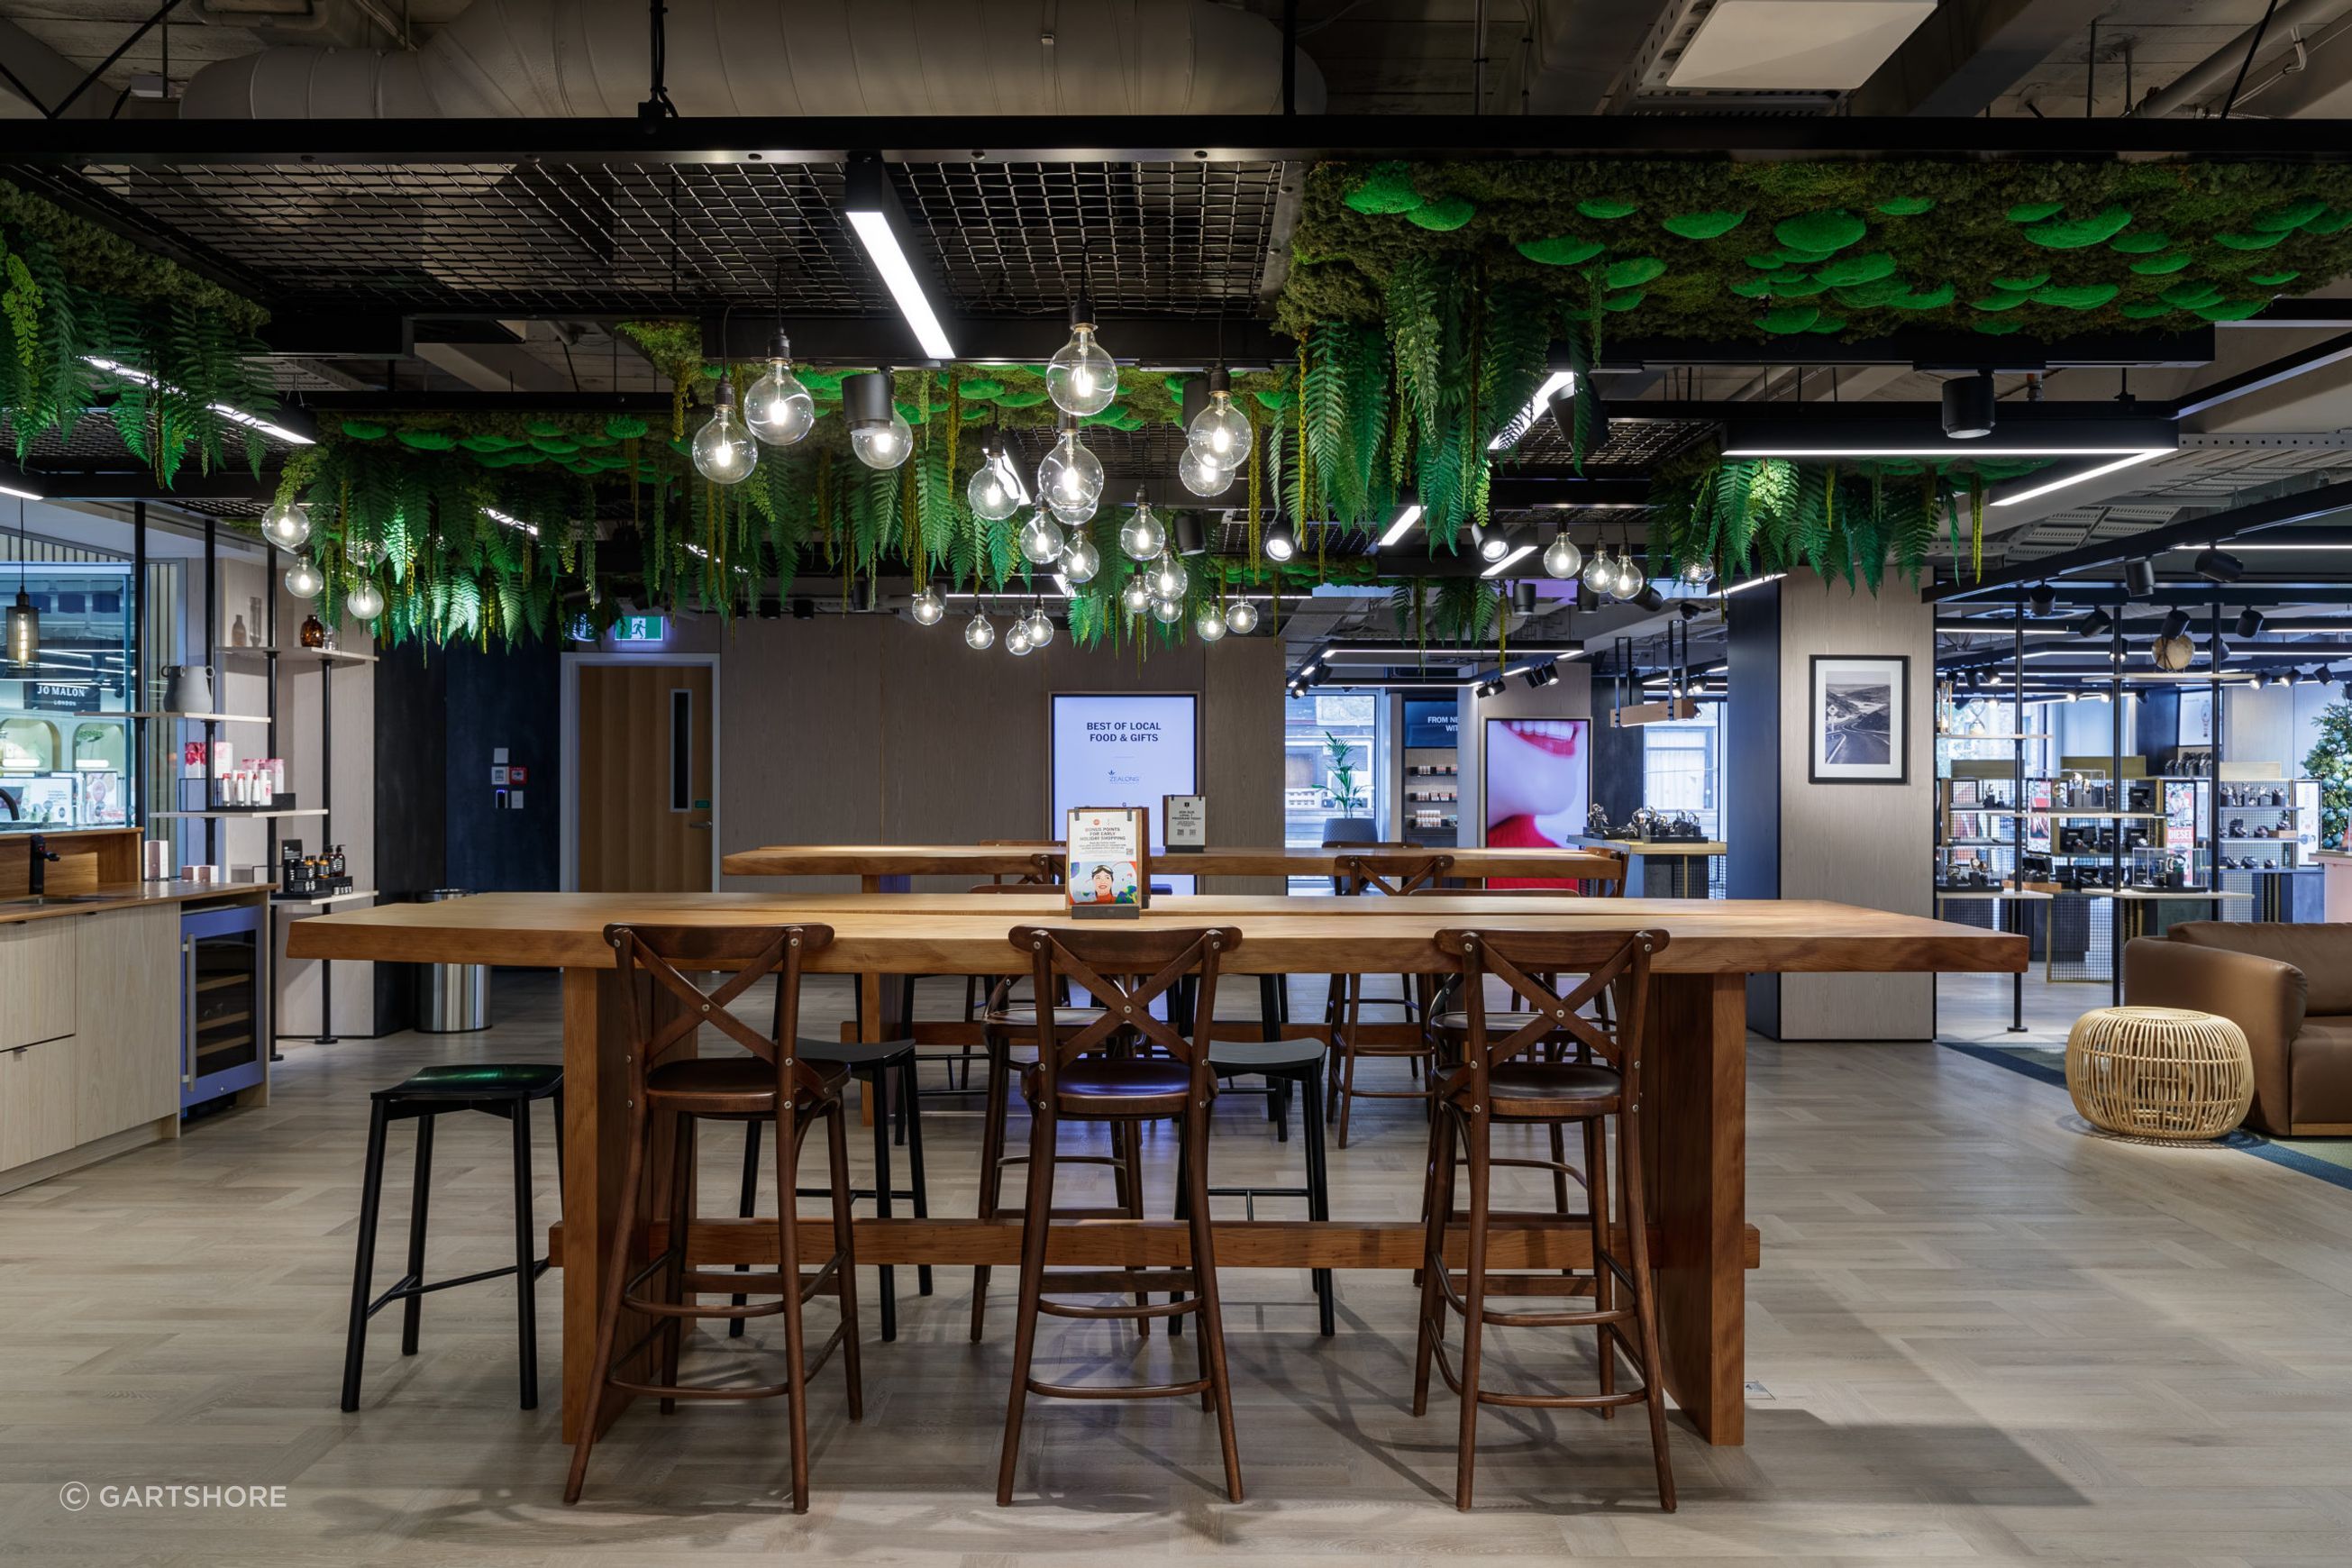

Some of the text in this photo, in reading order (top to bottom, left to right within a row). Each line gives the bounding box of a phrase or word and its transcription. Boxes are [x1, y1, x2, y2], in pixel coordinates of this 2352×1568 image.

[37, 686, 86, 697] JO MALON
[1087, 722, 1161, 731] BEST OF LOCAL
[1089, 734, 1158, 742] FOOD & GIFTS
[2168, 829, 2192, 839] DIESEL
